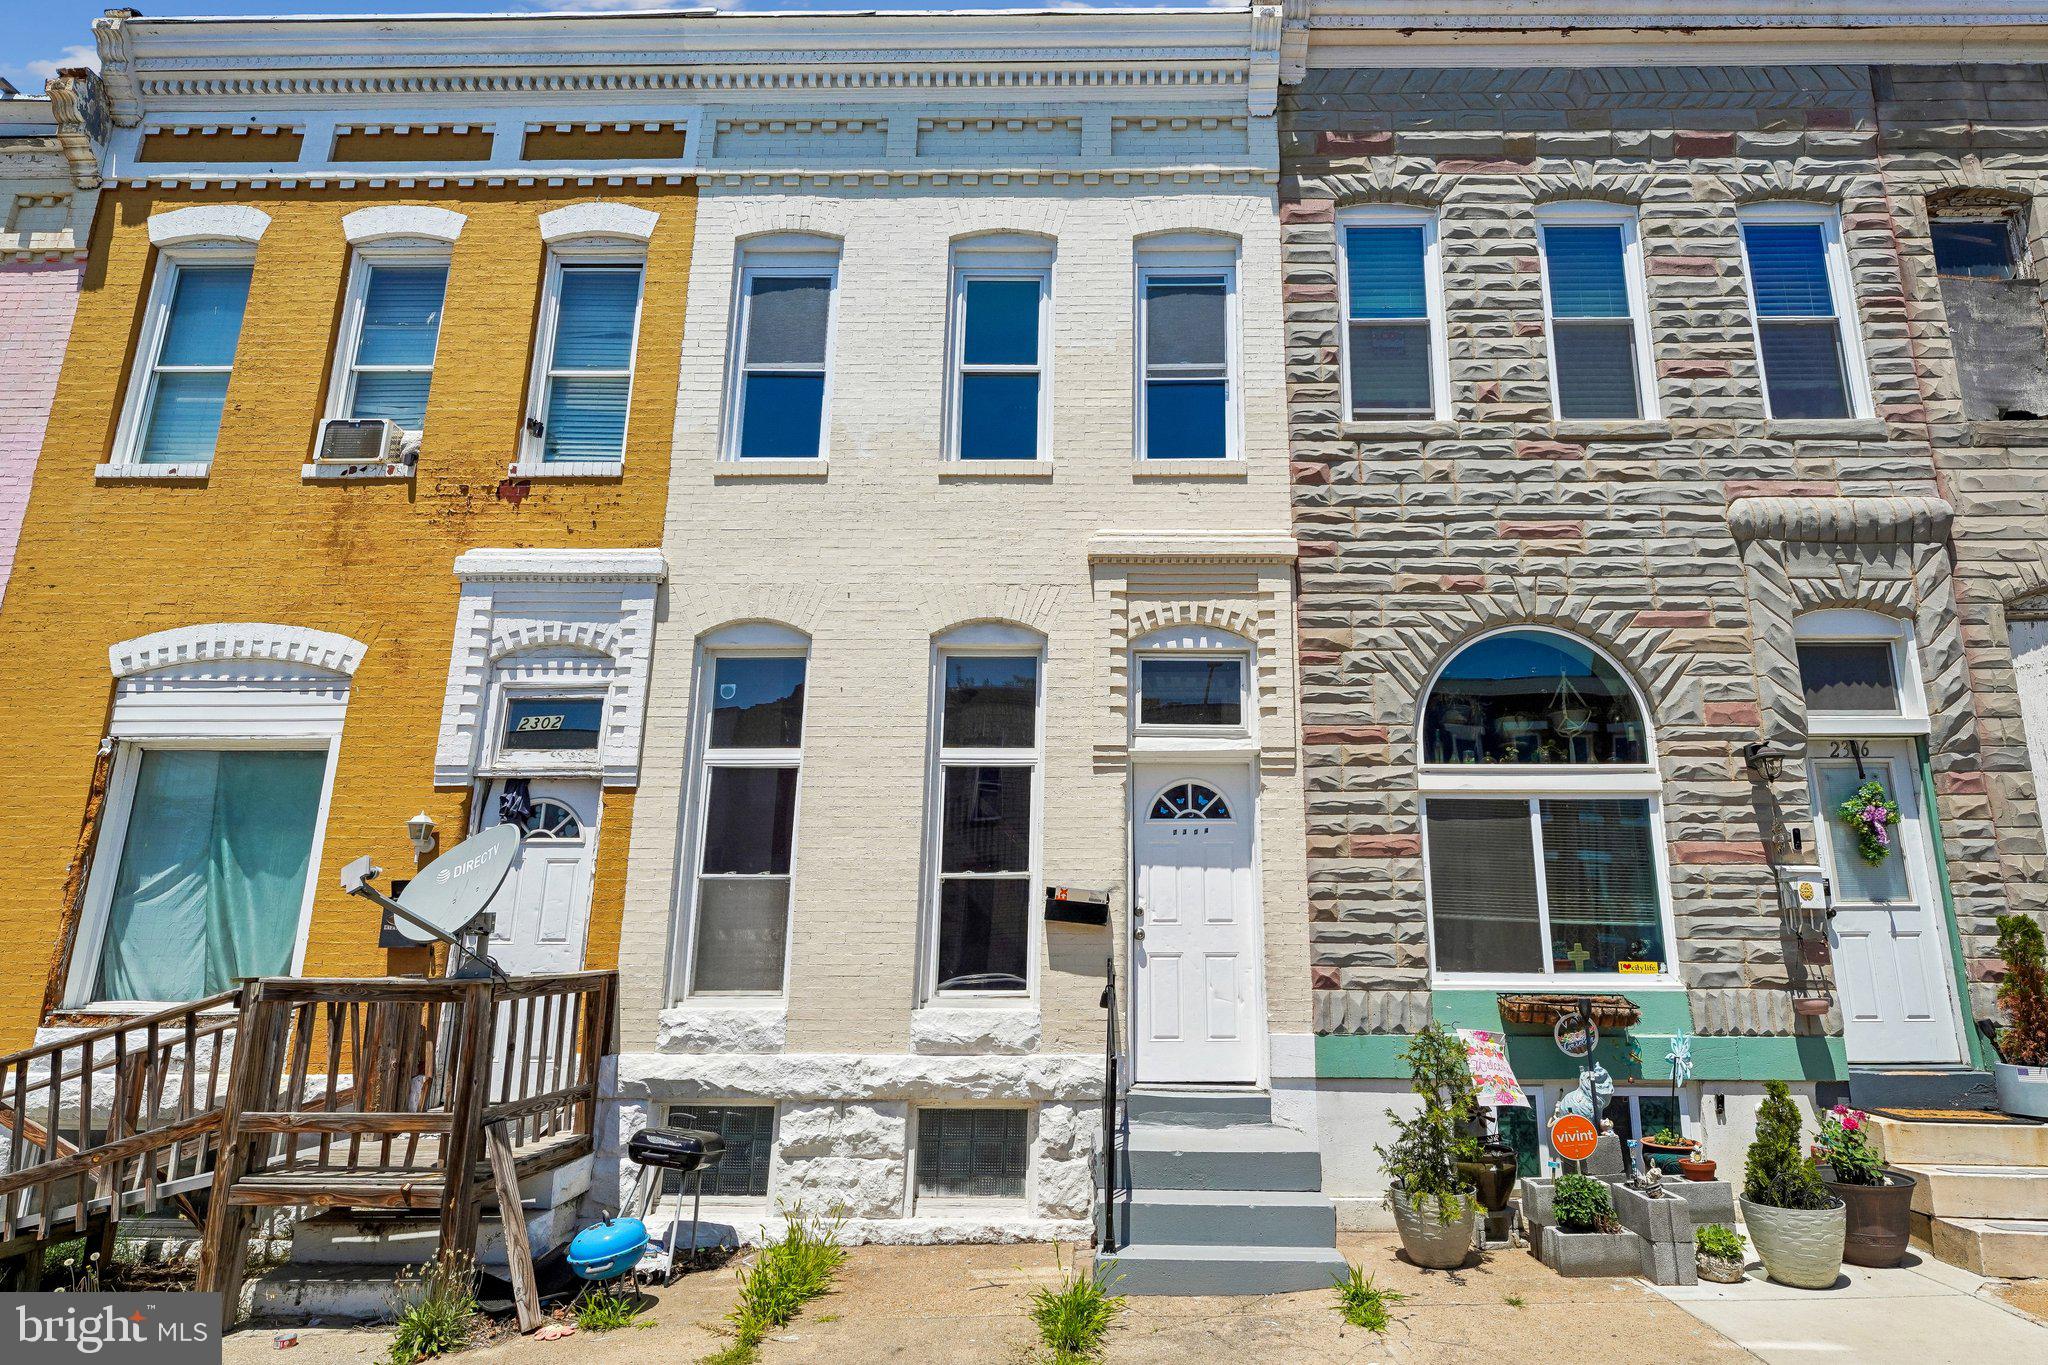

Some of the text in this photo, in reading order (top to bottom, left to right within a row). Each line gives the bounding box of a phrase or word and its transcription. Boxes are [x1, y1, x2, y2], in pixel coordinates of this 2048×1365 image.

[518, 716, 562, 730] 2302
[453, 843, 500, 878] DIRECTV
[1556, 1130, 1594, 1143] vivint
